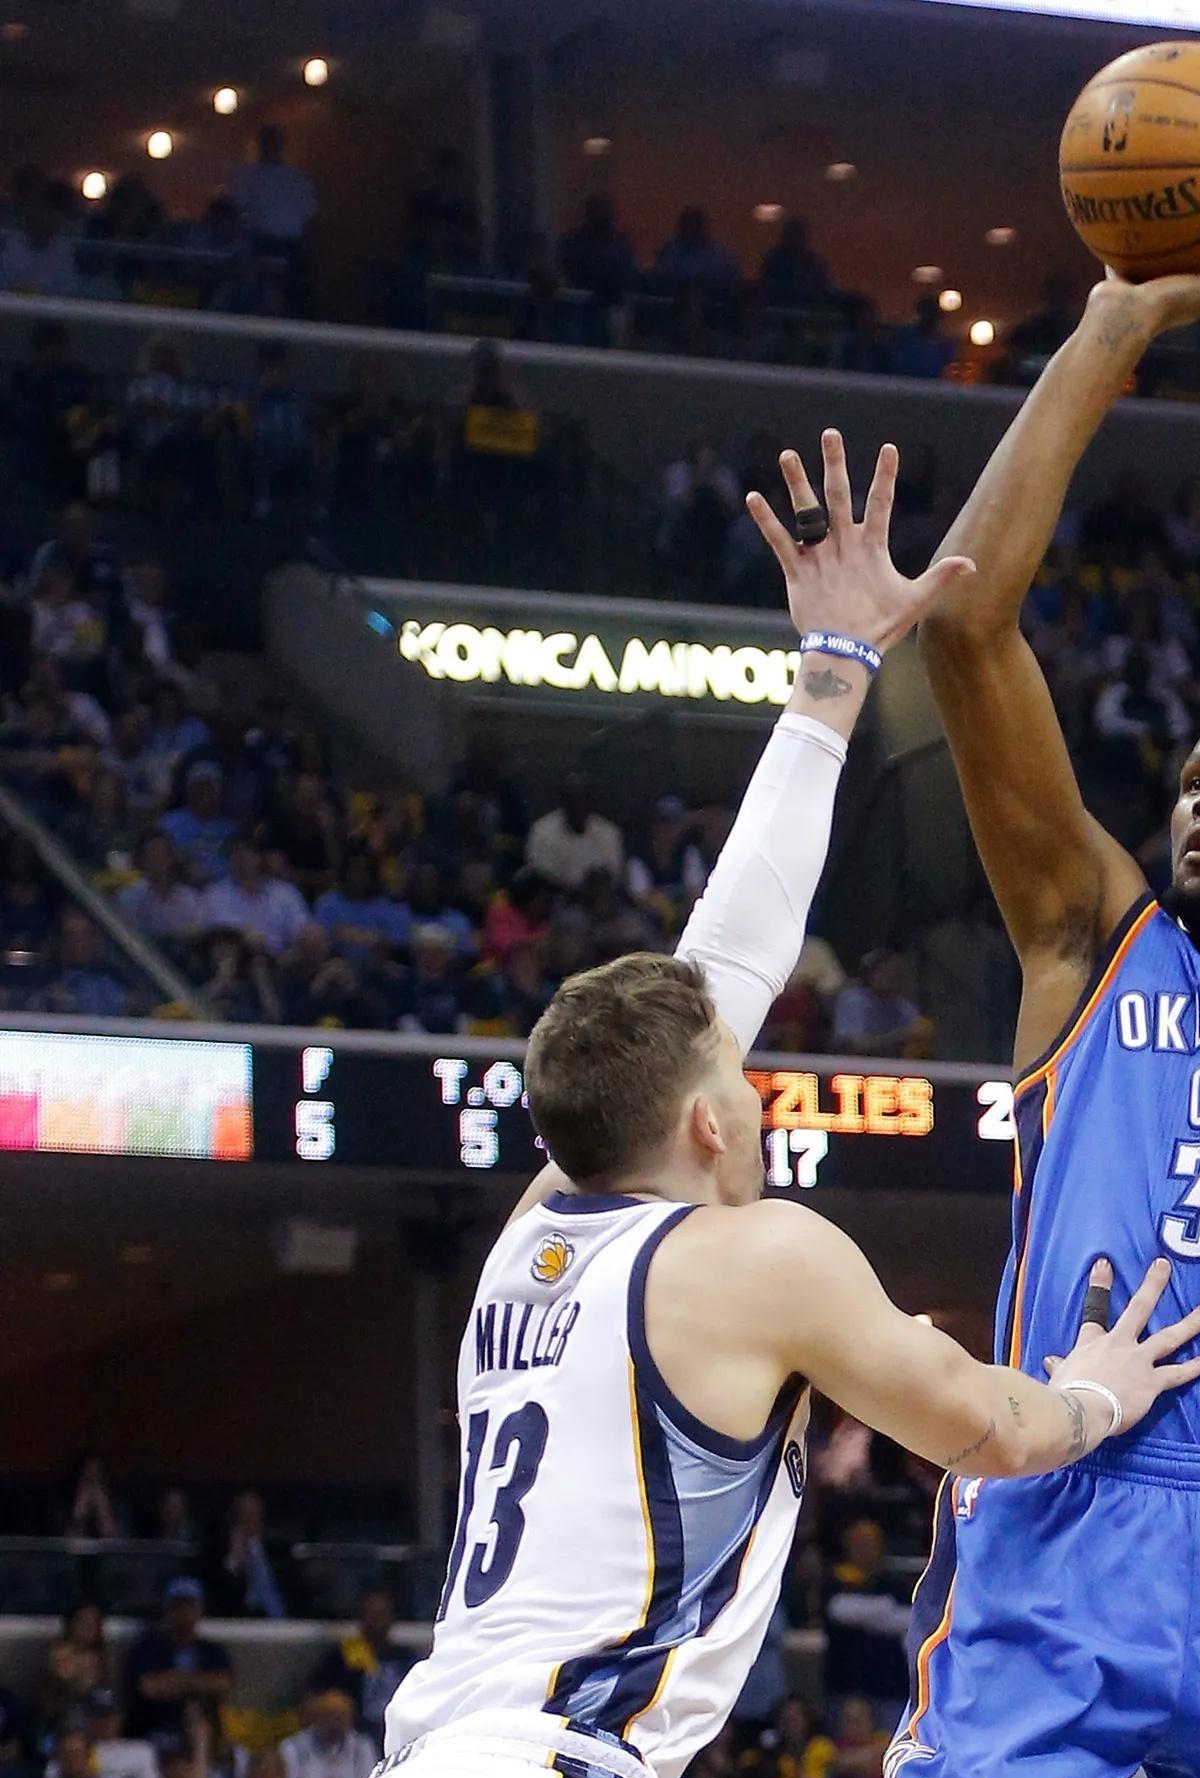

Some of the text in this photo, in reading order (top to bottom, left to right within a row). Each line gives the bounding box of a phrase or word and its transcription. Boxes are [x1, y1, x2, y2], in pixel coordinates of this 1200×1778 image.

[400, 620, 801, 705] KONICA MINOL
[302, 1046, 335, 1094] F
[295, 1099, 336, 1161] 5
[459, 1108, 499, 1169] 5
[766, 1128, 829, 1188] 17
[475, 1301, 581, 1377] MILLER
[436, 1400, 550, 1623] 13
